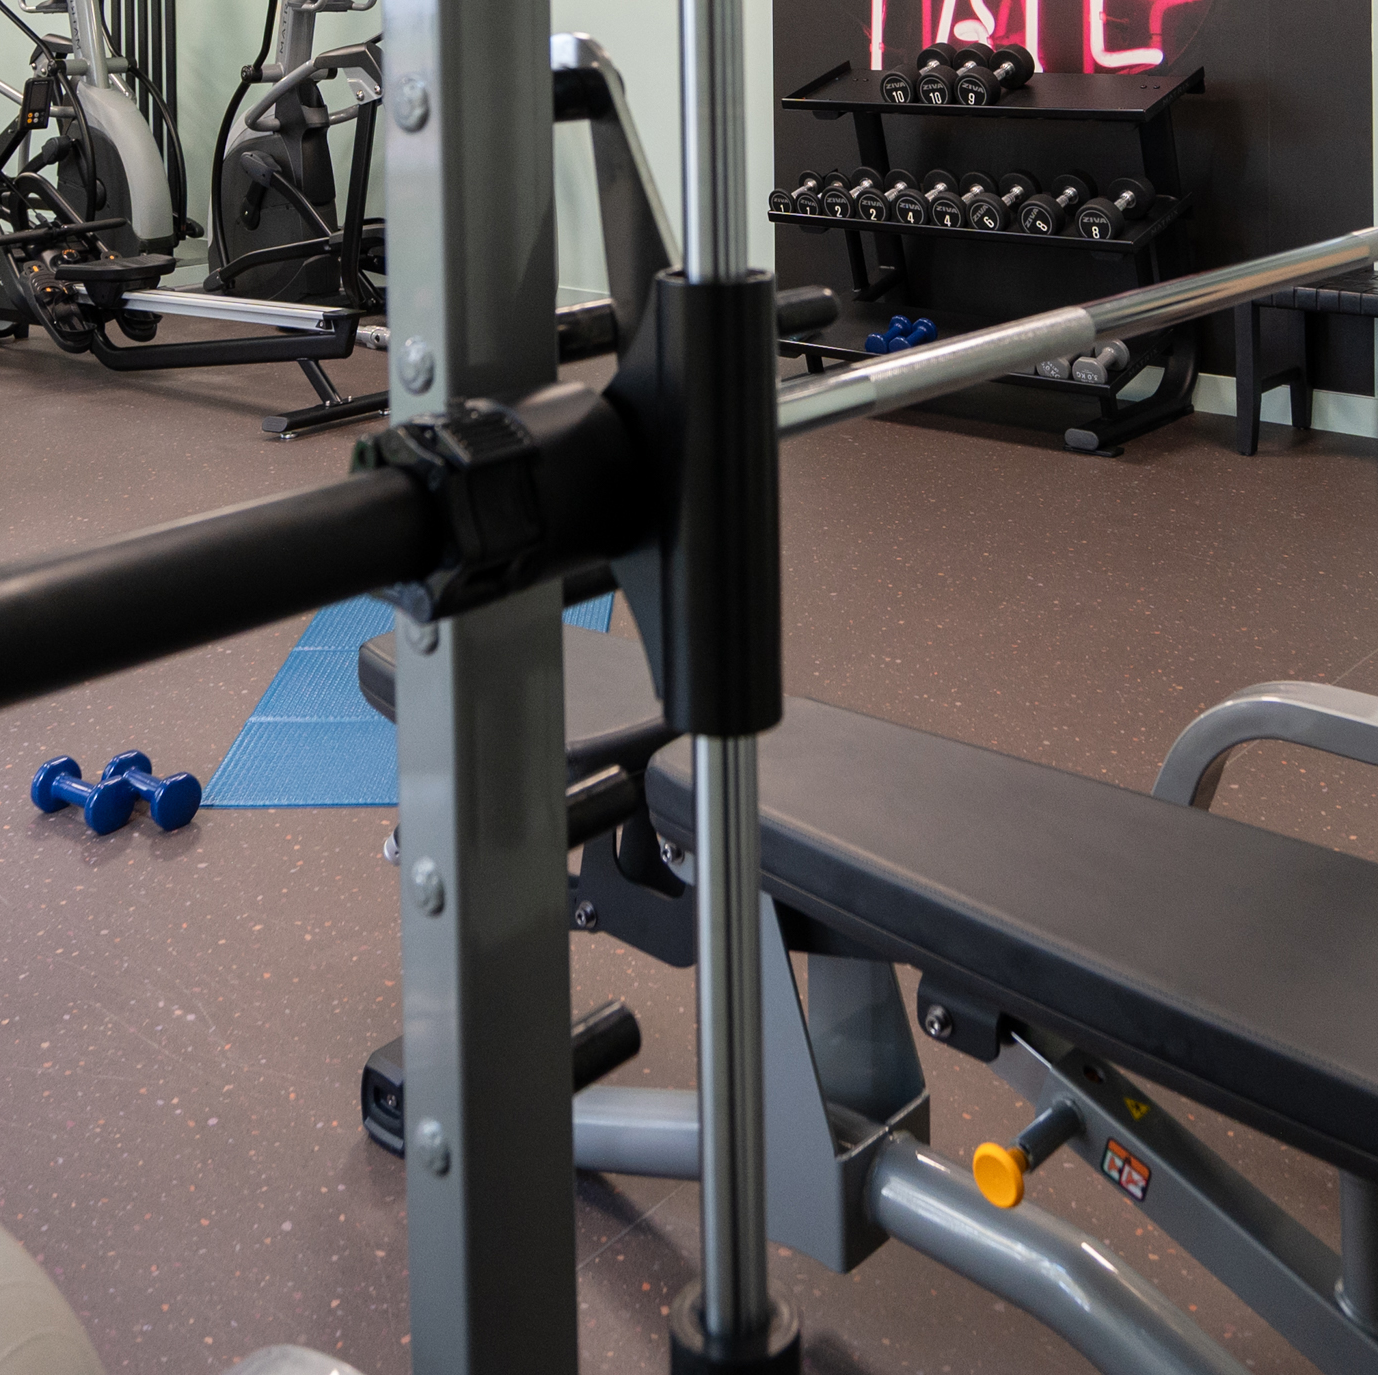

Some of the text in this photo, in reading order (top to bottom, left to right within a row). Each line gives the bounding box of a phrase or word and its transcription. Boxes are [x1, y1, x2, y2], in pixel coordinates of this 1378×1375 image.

[923, 83, 943, 91] ZIVA
[962, 83, 984, 93] ZIVA
[892, 90, 905, 103] 10
[929, 91, 942, 104] 10
[968, 93, 975, 105] 9
[780, 204, 785, 213] 1
[861, 199, 883, 207] ZIVA
[899, 202, 922, 211] ZIVA
[806, 206, 811, 215] 1
[835, 206, 843, 218] 2
[869, 208, 877, 221] 2
[936, 205, 958, 214] ZIVA
[972, 205, 989, 223] ZIVA
[907, 212, 914, 224] 4
[944, 215, 951, 227] 4
[983, 216, 995, 228] 6
[1025, 208, 1039, 228] ZIVA
[1082, 216, 1107, 224] ZIVA
[1036, 220, 1048, 231] 8
[1092, 226, 1100, 239] 8
